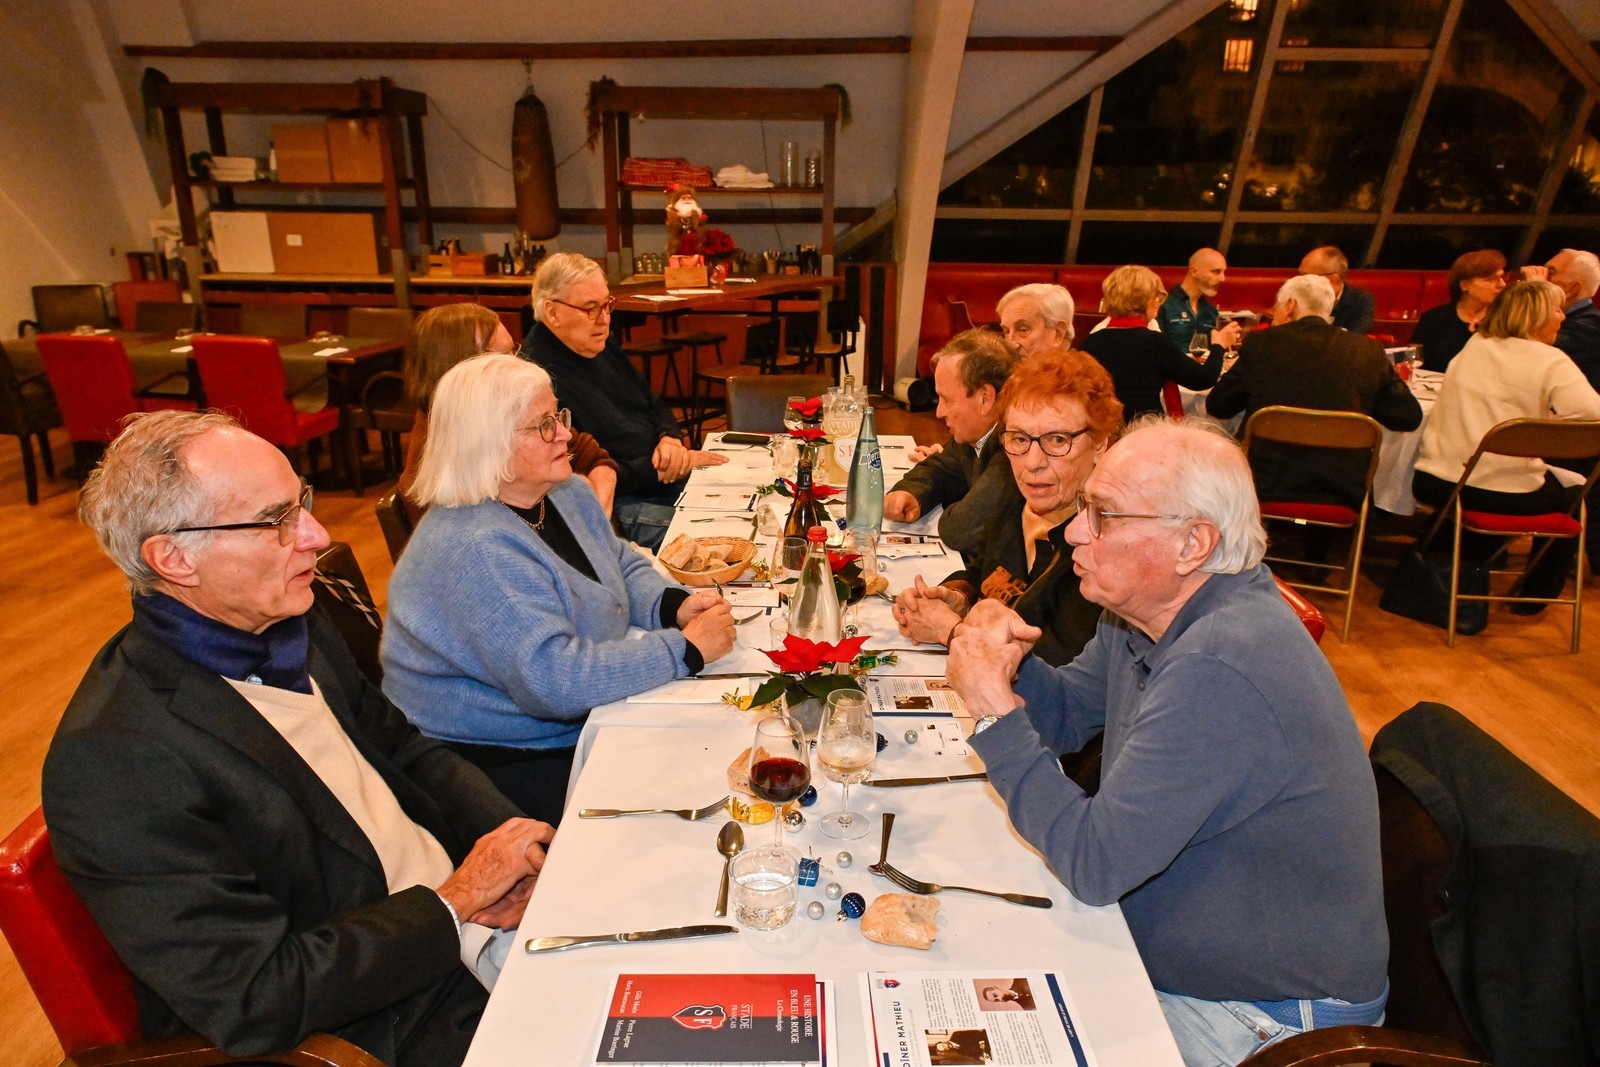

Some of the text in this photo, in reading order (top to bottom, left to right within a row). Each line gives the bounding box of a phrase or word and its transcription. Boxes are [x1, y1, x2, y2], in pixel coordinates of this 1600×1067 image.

[790, 989, 798, 998] EN
[614, 1020, 624, 1036] Martine
[627, 1020, 636, 1032] Pierre
[730, 1004, 738, 1029] FRANÇAIS
[740, 1004, 750, 1030] STADE
[775, 1006, 784, 1032] Chronologie
[804, 994, 813, 1037] UNE HISTOIRE
[893, 1001, 906, 1038] MATHIEU
[790, 1022, 799, 1044] ROUGE
